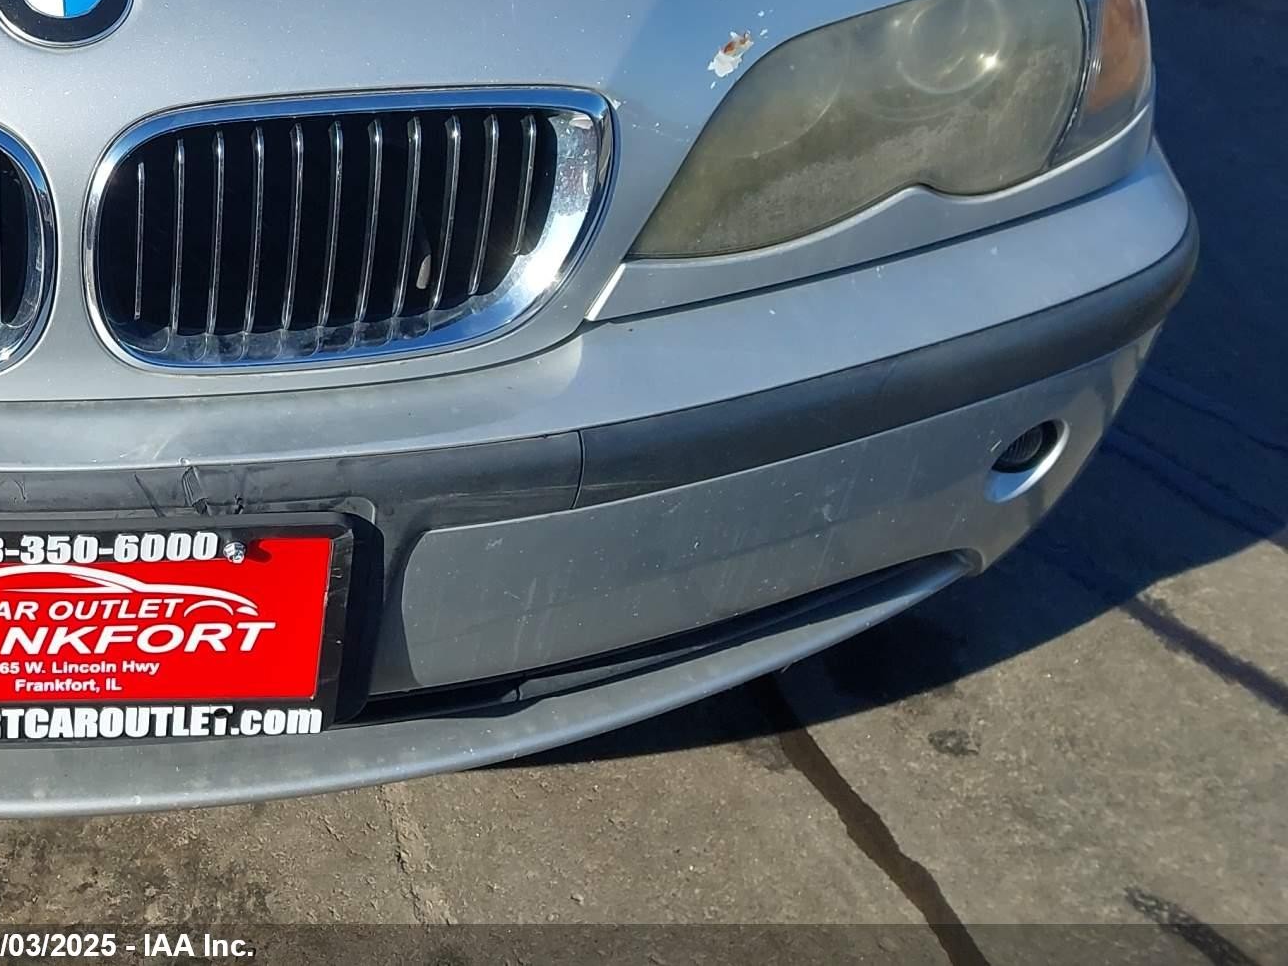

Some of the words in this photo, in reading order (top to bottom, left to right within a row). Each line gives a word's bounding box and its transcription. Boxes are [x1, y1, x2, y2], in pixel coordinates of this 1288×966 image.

[48, 598, 185, 622] OUTLET
[24, 661, 47, 675] W.
[51, 660, 117, 675] Lincoln
[121, 660, 160, 676] Hwy
[14, 677, 101, 694] Frankfort,
[105, 677, 123, 691] IL
